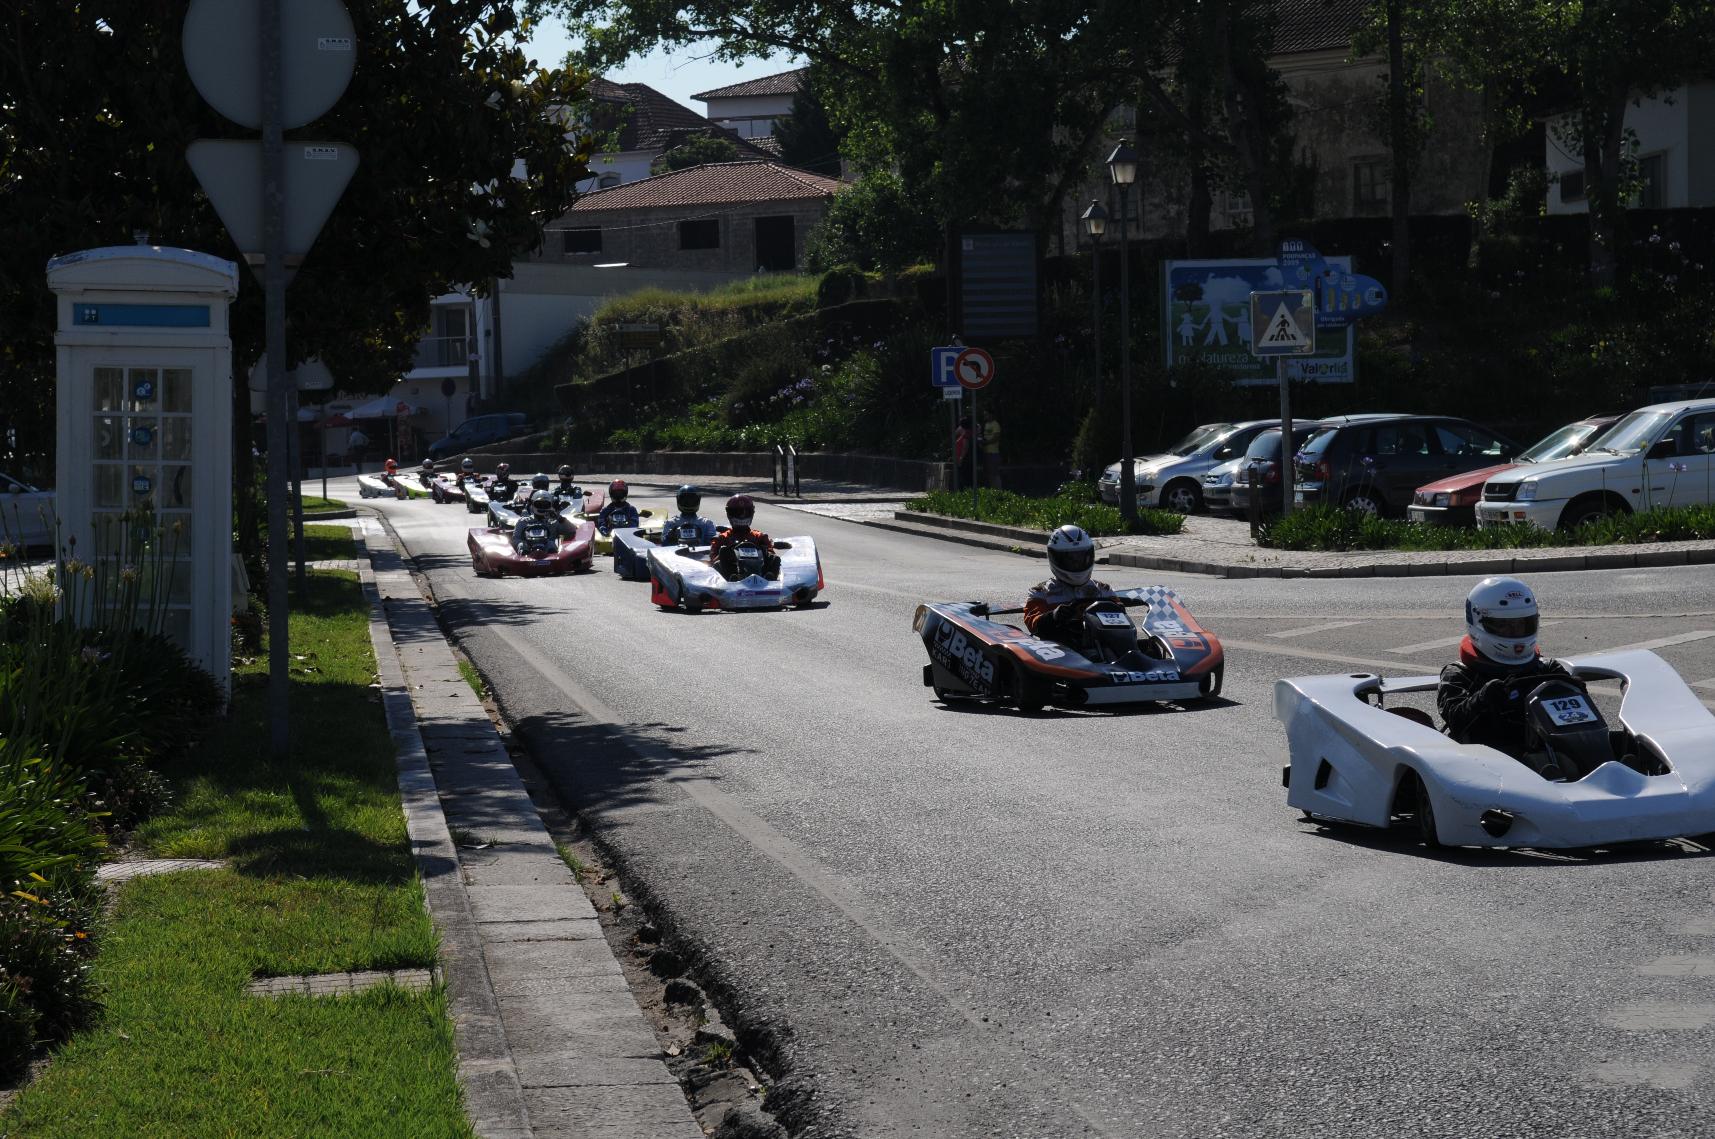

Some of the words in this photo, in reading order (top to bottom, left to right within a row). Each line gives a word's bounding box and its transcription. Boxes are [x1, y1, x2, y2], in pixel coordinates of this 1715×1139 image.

[940, 352, 959, 383] P
[949, 629, 994, 683] Beta
[1128, 671, 1180, 682] Beta
[1550, 699, 1581, 711] 129
